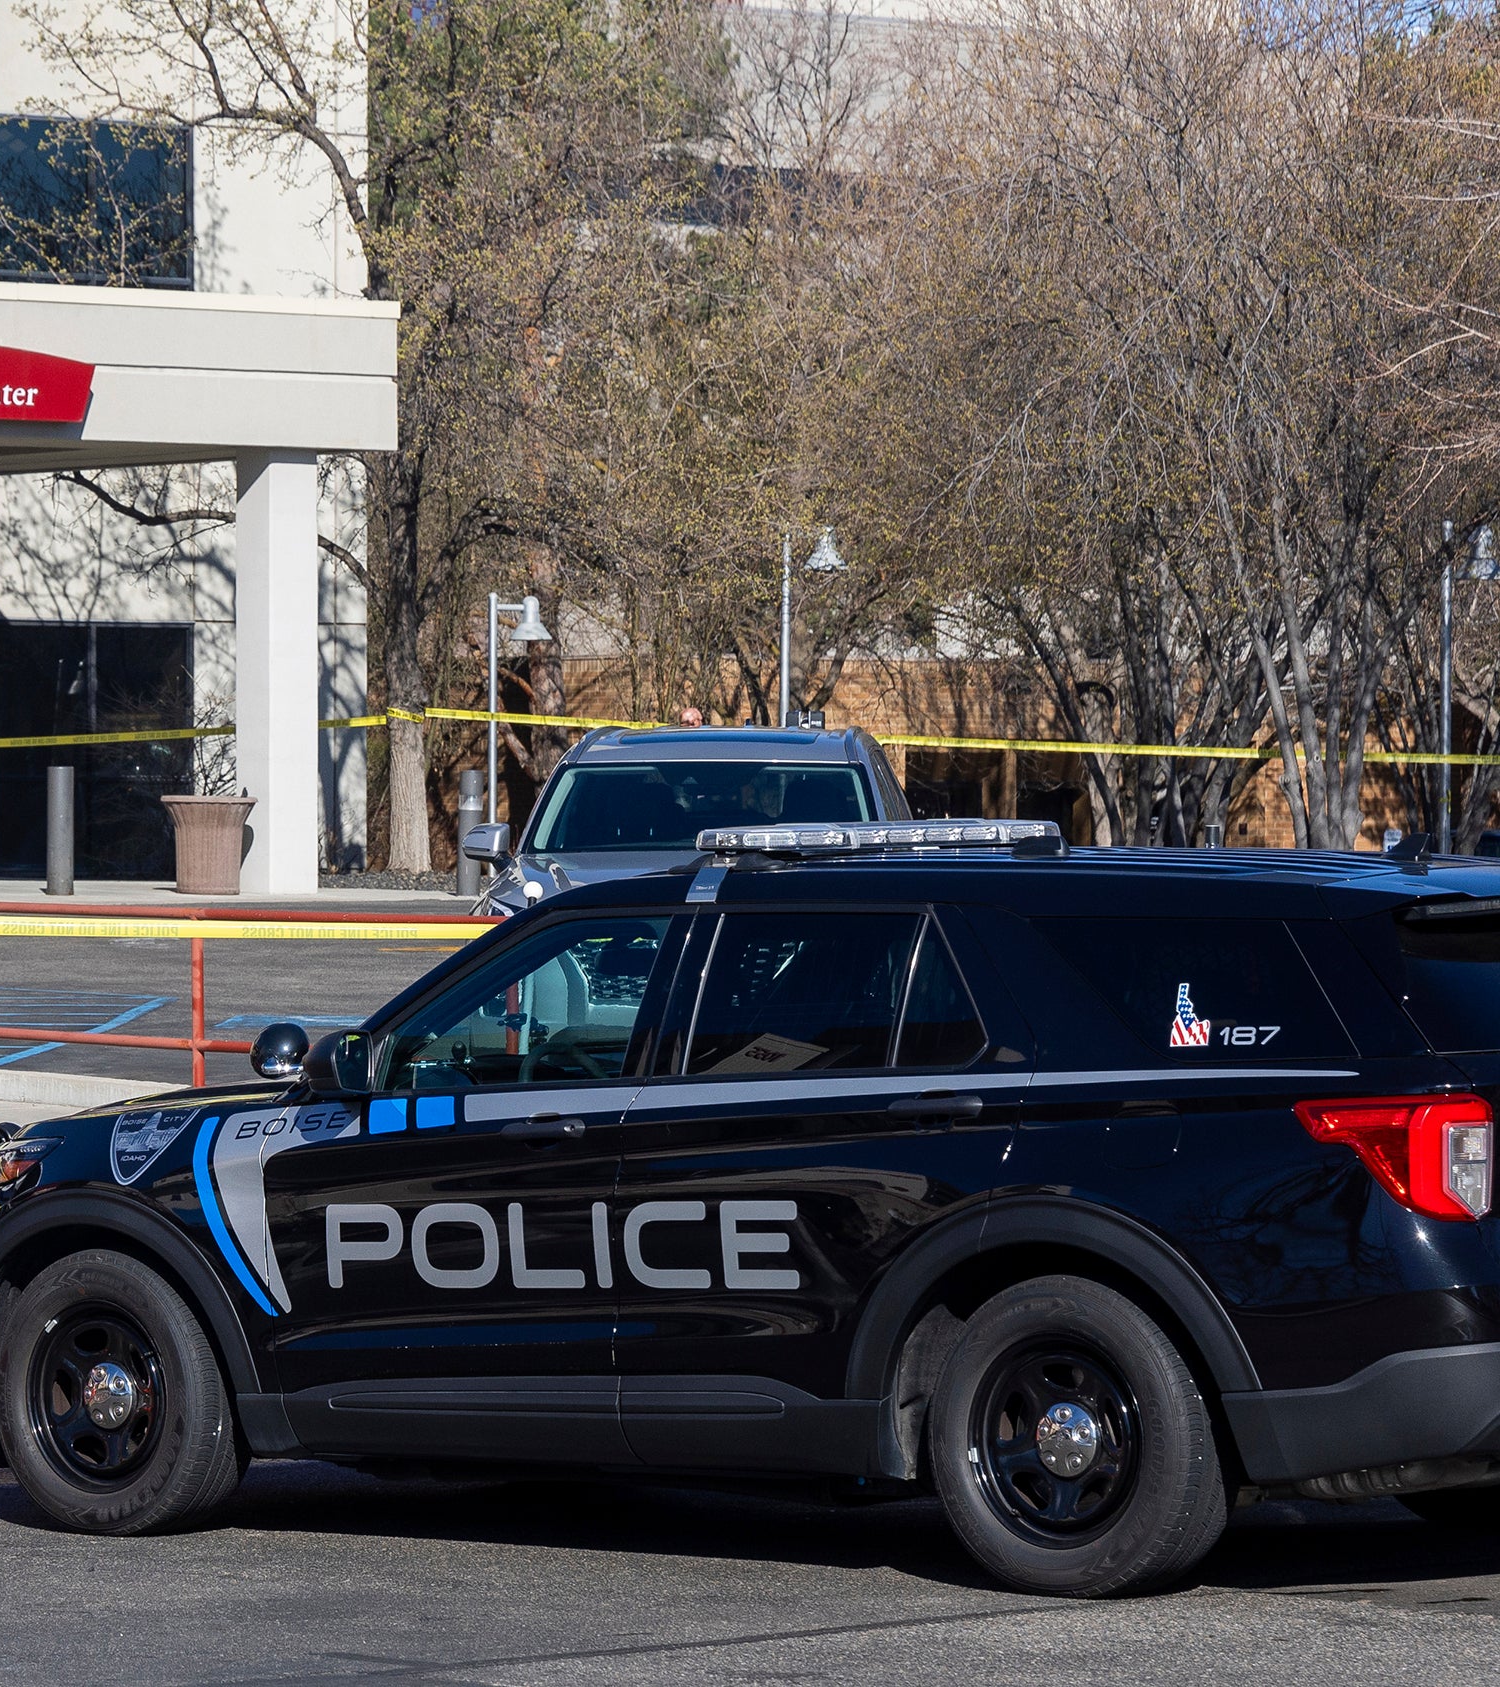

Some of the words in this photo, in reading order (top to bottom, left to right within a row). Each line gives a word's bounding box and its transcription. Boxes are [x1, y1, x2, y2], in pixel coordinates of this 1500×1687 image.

[1219, 1026, 1281, 1046] 187
[121, 1117, 147, 1126] BOISE
[163, 1114, 187, 1123] CITY
[235, 1109, 352, 1140] BOISE
[120, 1154, 147, 1162] IDAHO
[325, 1200, 800, 1290] POLICE
